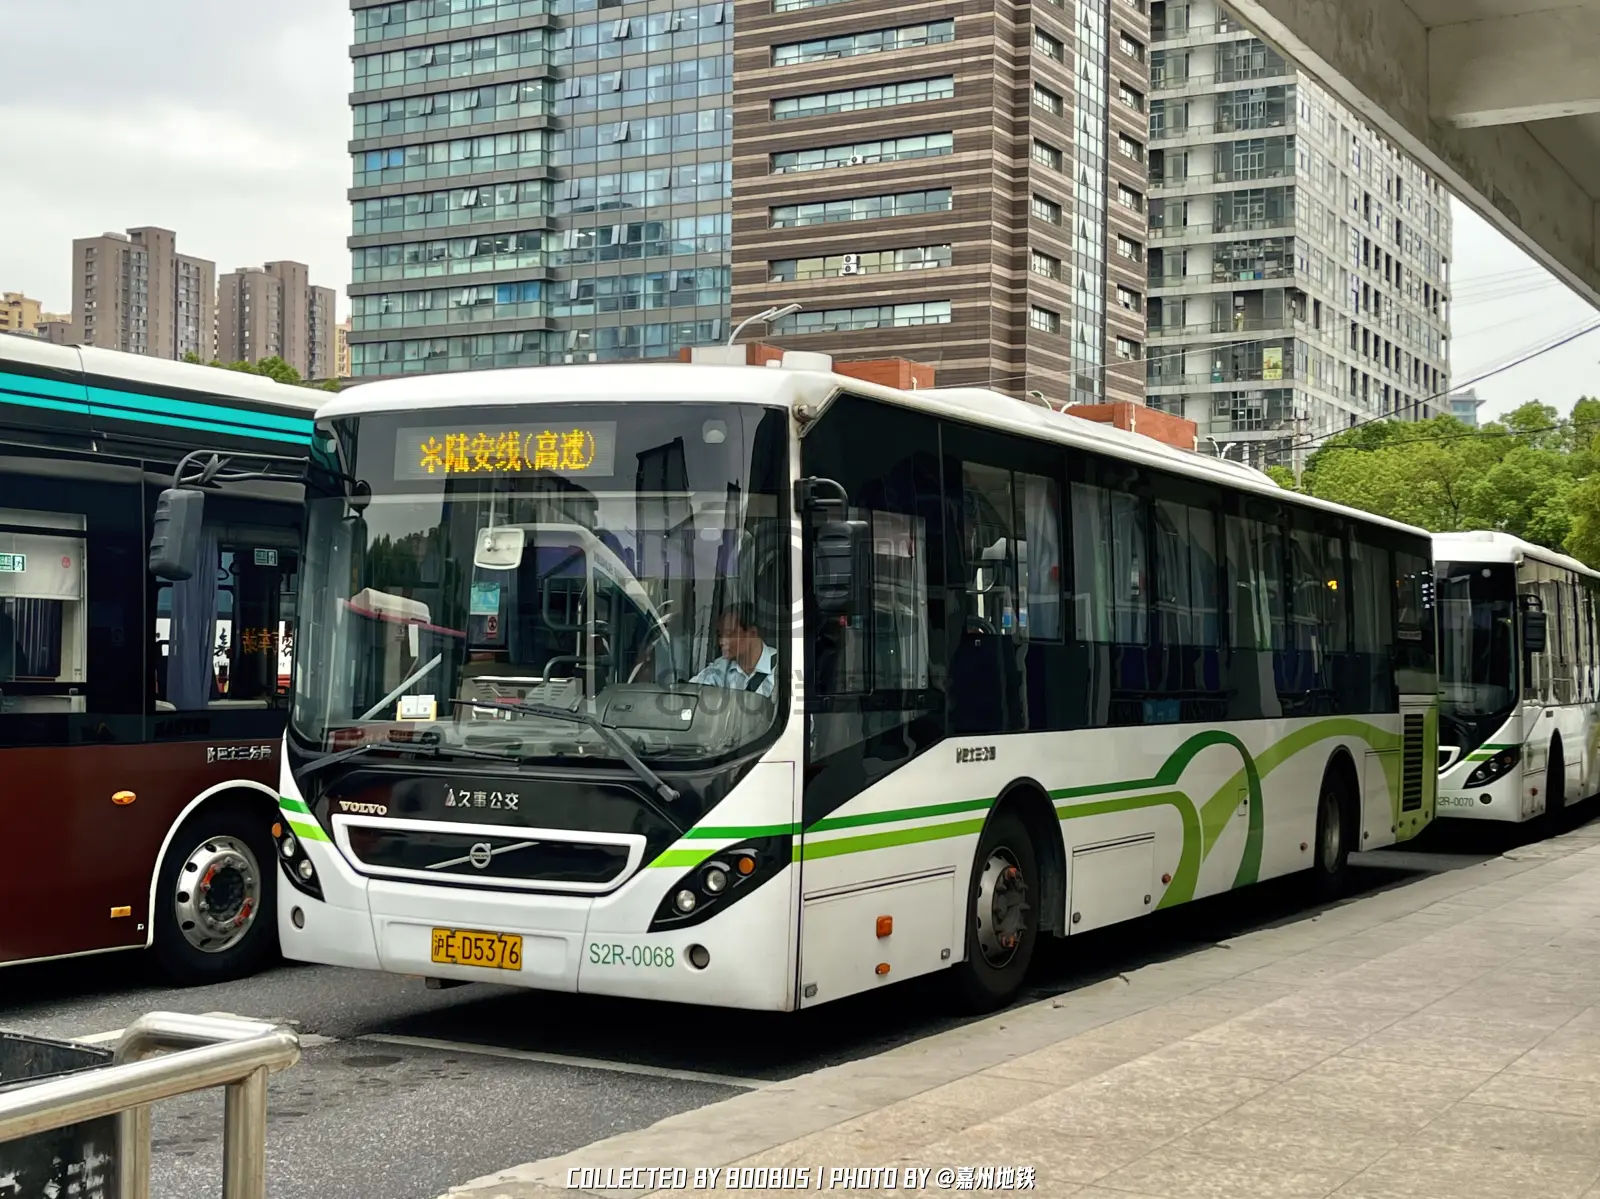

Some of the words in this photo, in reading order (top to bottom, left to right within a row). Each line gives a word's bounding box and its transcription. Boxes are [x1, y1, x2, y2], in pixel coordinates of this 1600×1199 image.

[338, 800, 388, 816] VOLVO
[457, 789, 519, 810] 久事公交
[589, 942, 675, 968] S2R-0068
